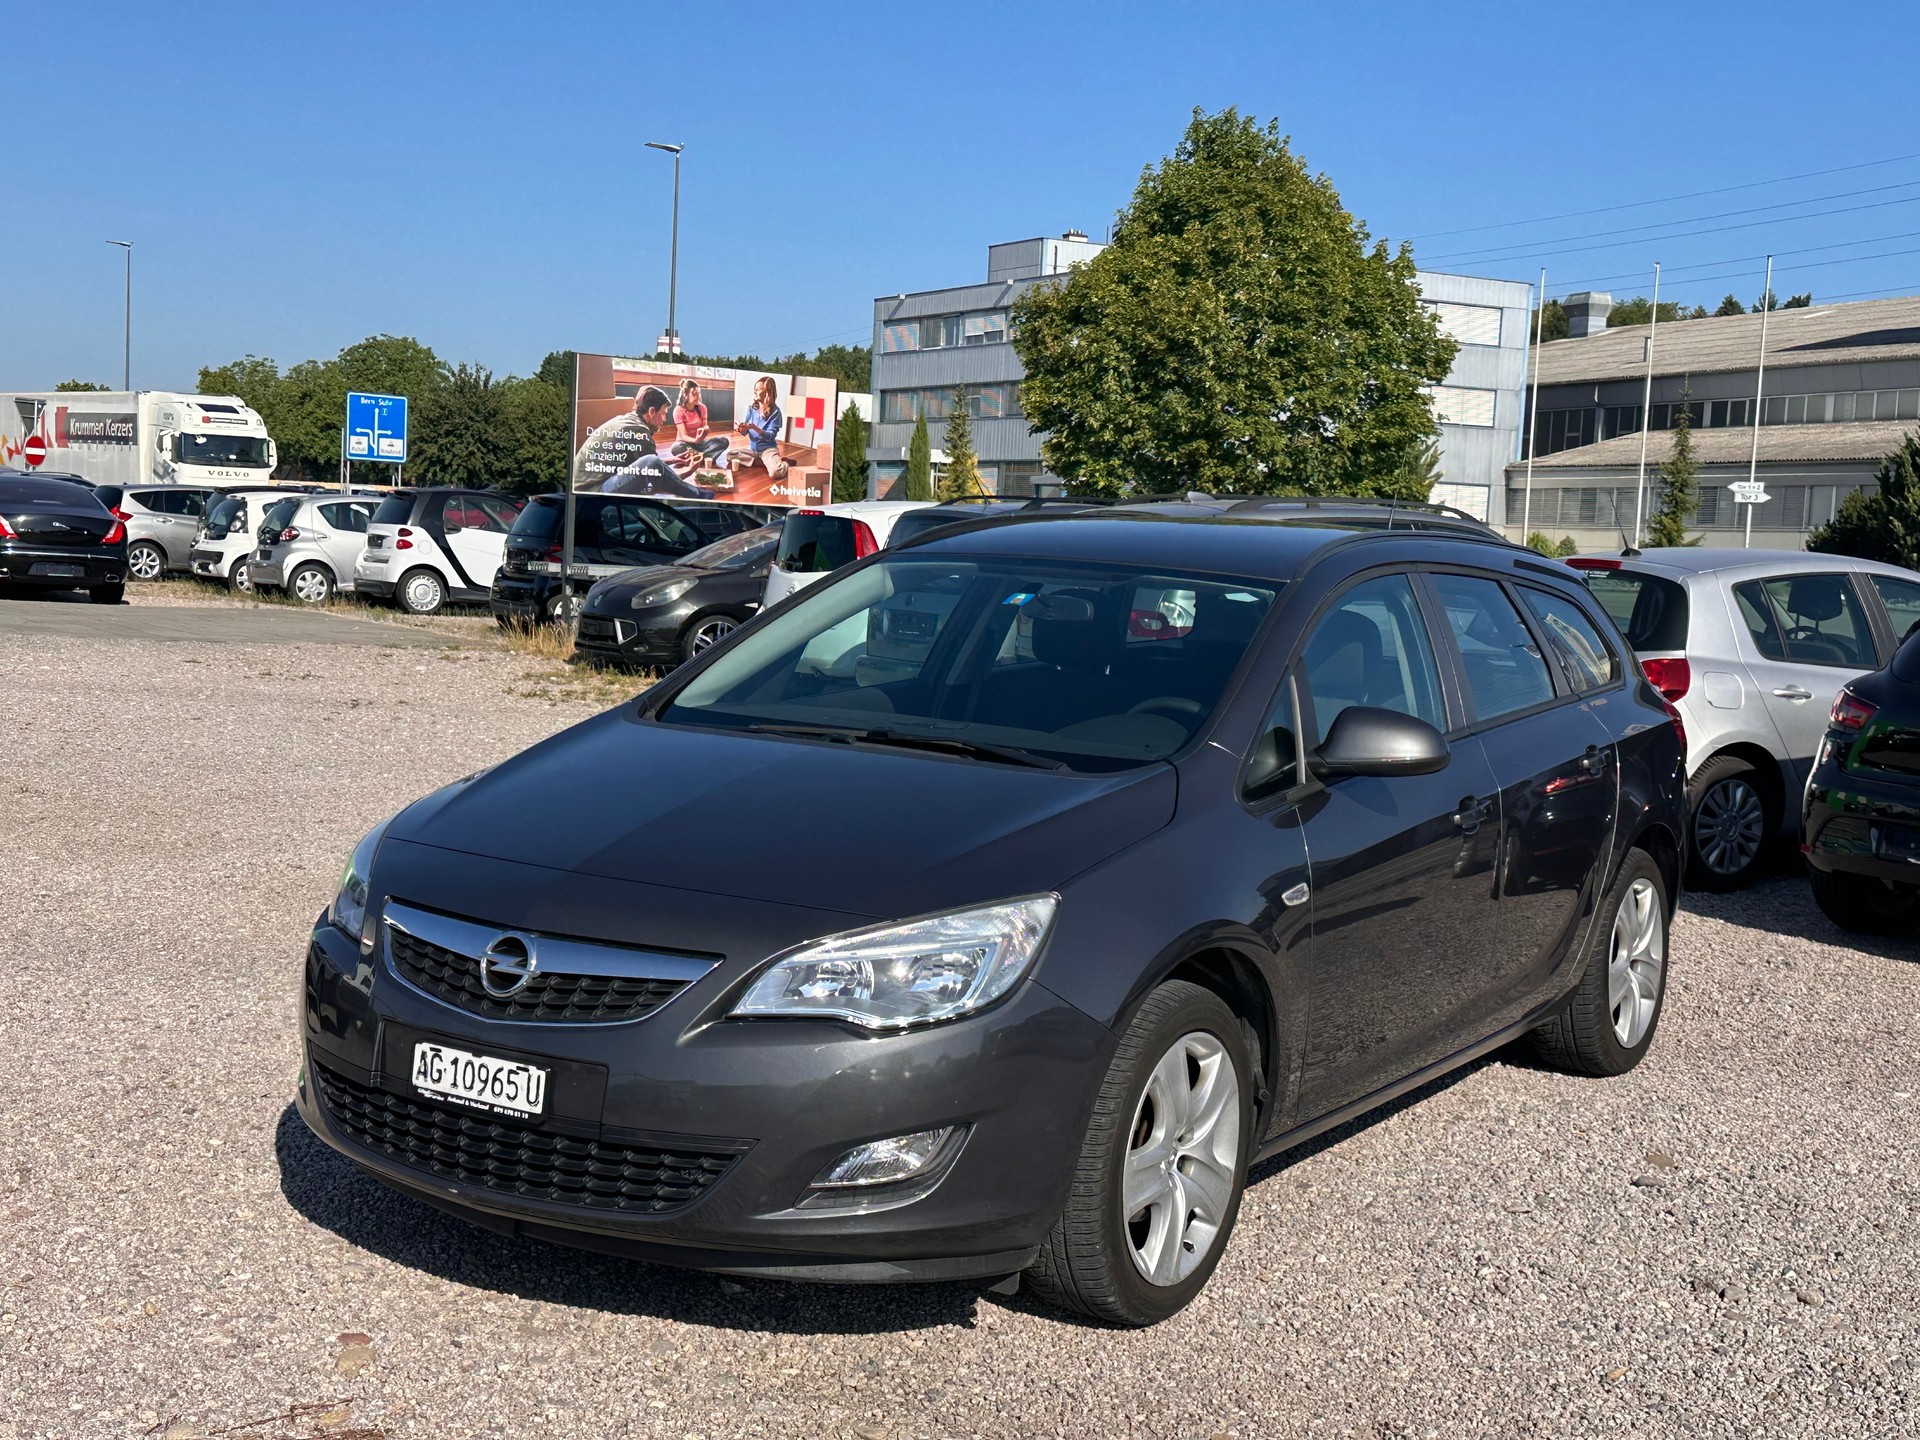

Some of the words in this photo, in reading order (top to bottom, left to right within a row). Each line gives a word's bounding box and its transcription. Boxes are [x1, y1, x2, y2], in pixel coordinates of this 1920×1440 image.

[69, 418, 104, 436] Krummen
[105, 418, 133, 437] Kerzers
[586, 426, 600, 436] Da
[602, 428, 650, 441] hinziehen,
[586, 441, 600, 449] wo
[602, 441, 613, 450] es
[615, 441, 642, 451] einen
[585, 450, 627, 462] hinzieht?
[208, 470, 249, 478] VOLVO
[585, 462, 616, 473] Sicher
[616, 465, 640, 476] geht
[640, 466, 662, 476] das.
[780, 484, 821, 498] helvetia
